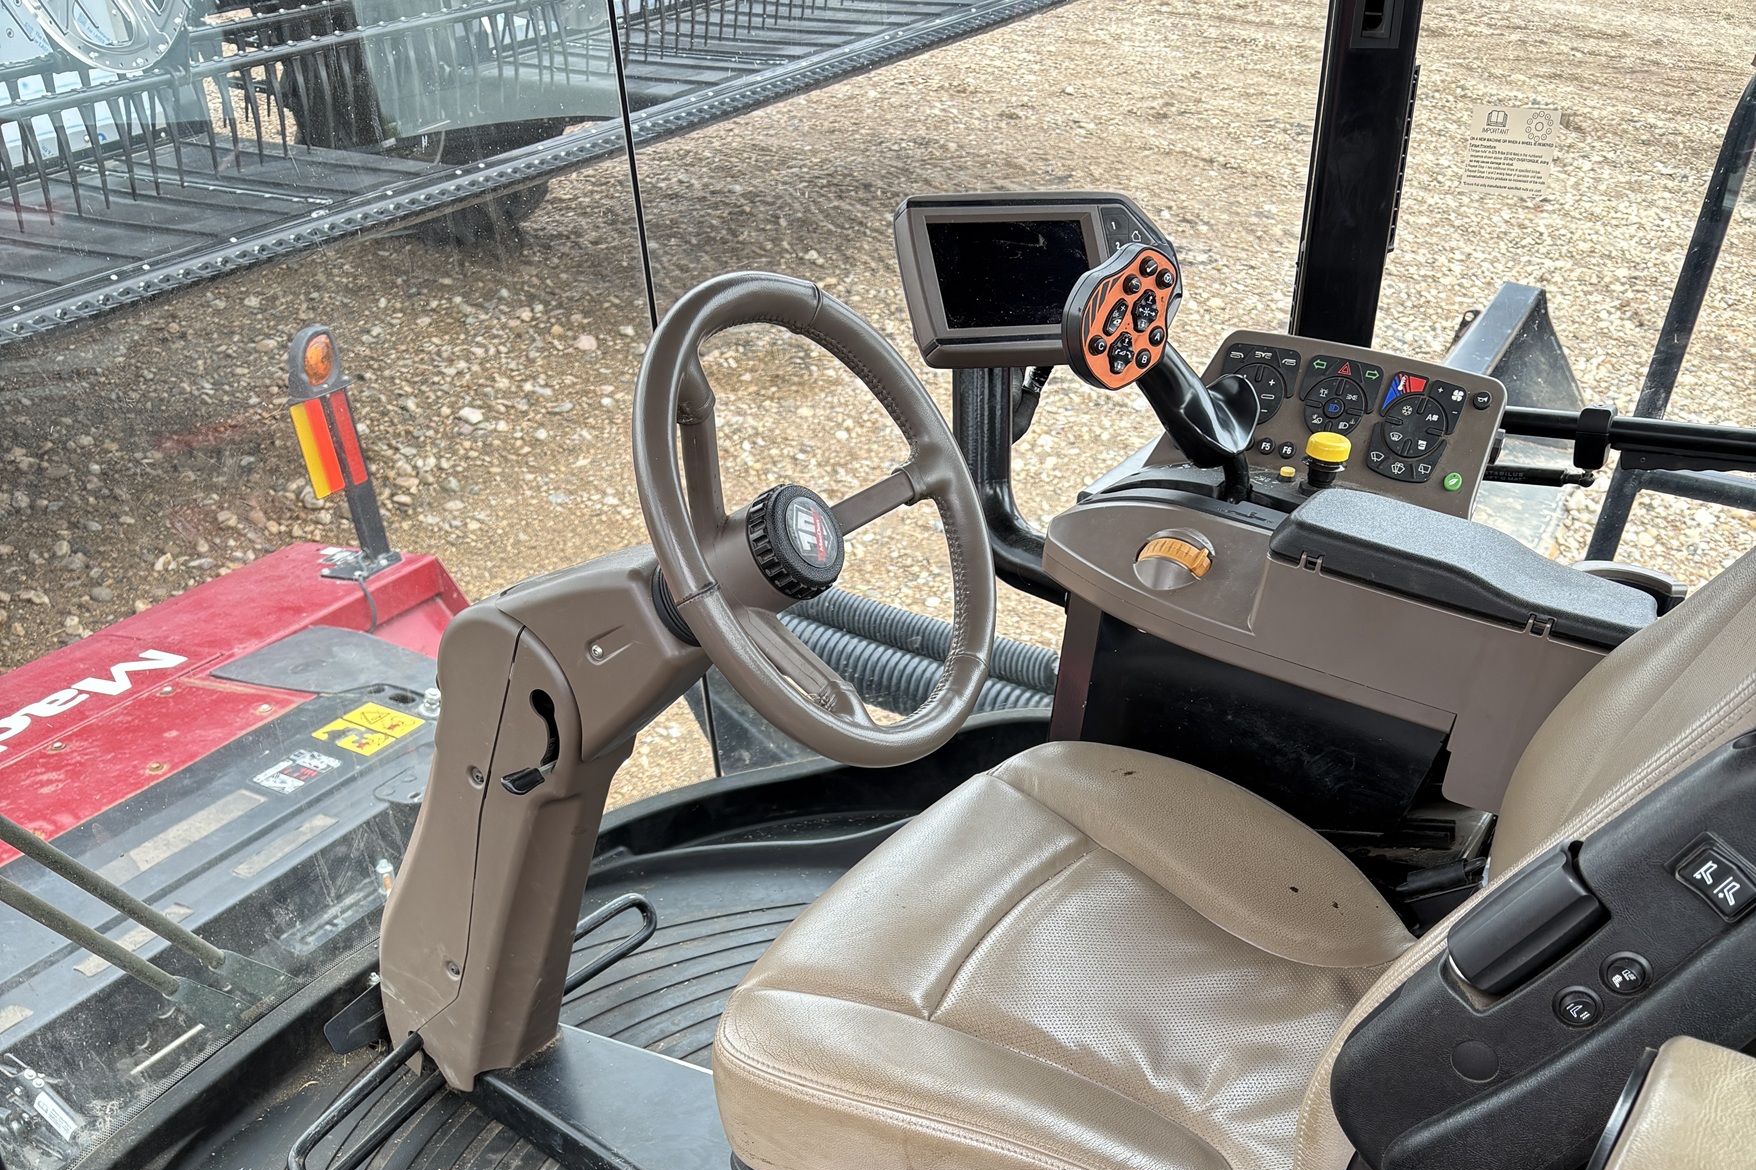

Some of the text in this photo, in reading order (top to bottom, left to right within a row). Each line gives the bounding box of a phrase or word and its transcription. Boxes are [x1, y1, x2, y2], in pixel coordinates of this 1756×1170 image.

[1111, 221, 1117, 230] 1
[1115, 241, 1121, 250] 2
[1154, 332, 1161, 341] A
[1099, 340, 1105, 350] C
[1141, 355, 1148, 365] B
[1261, 441, 1271, 451] F5
[1282, 446, 1293, 455] F6
[0, 649, 189, 751] Mac
